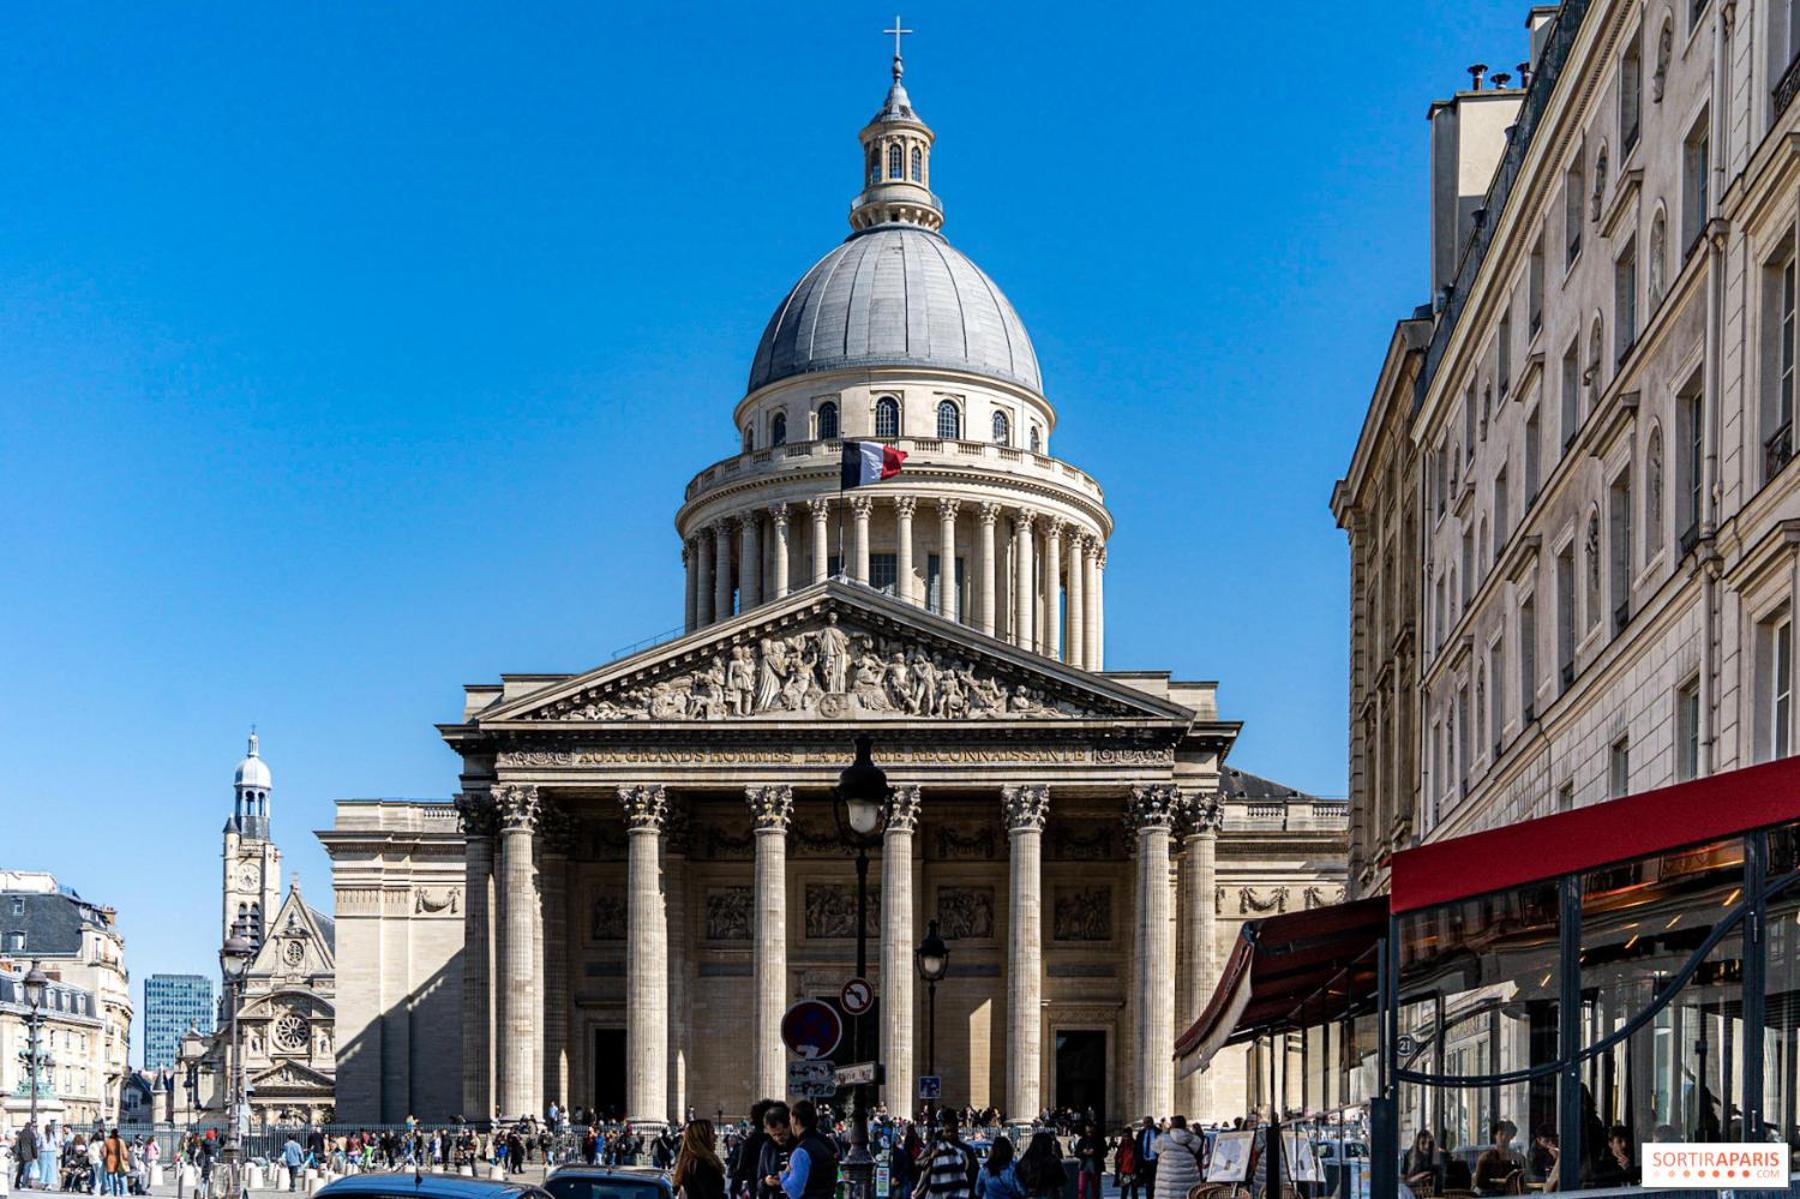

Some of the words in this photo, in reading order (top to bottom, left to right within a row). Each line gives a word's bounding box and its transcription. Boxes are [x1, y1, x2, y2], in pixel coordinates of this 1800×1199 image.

[579, 749, 621, 763] AUX
[625, 749, 704, 763] GRANDS
[709, 749, 793, 763] HOMMES
[805, 749, 831, 763] LA
[911, 749, 1087, 762] RECONNAISSANTE
[1399, 1040, 1411, 1051] 21
